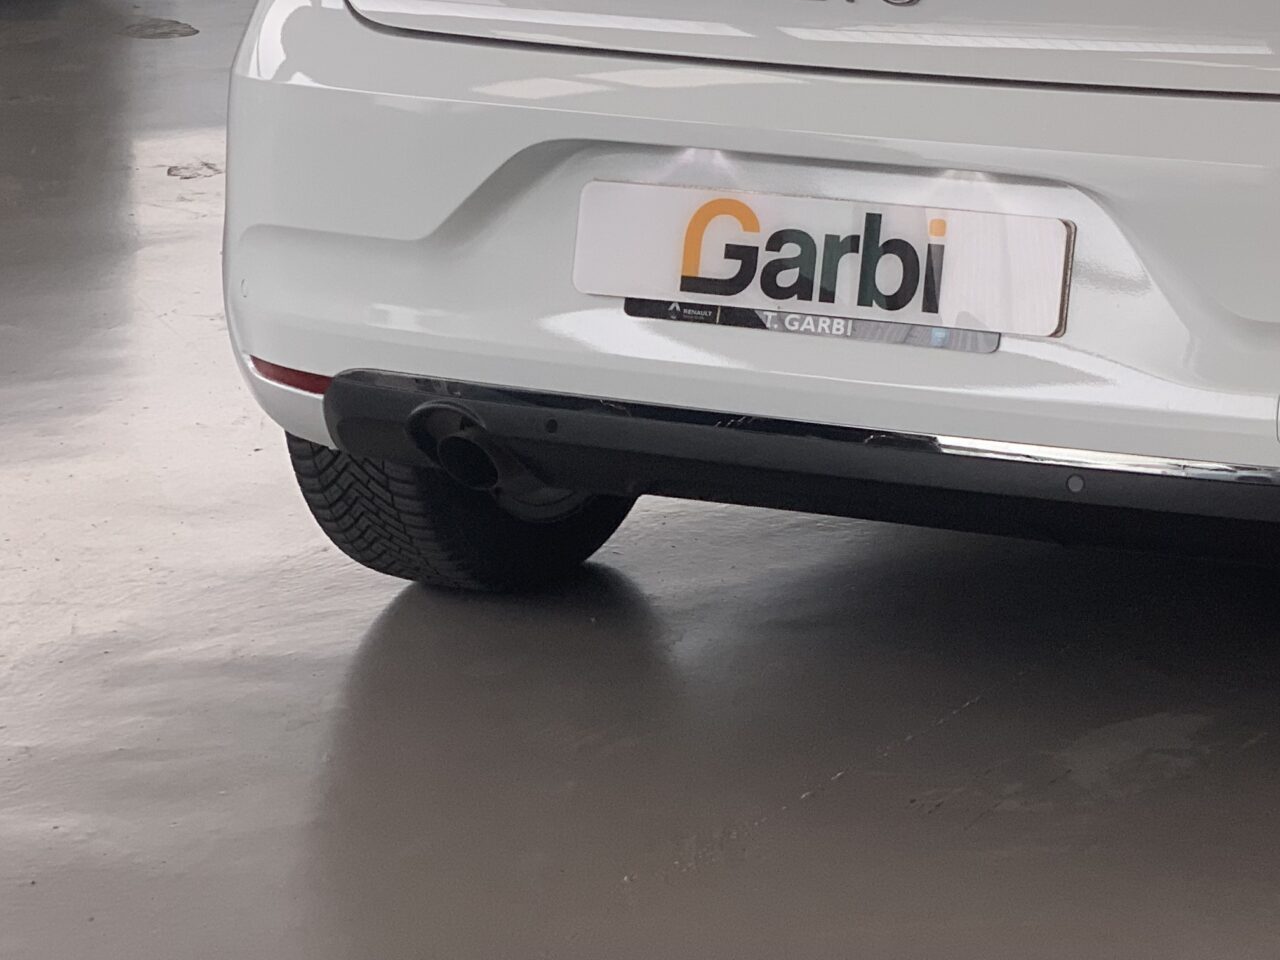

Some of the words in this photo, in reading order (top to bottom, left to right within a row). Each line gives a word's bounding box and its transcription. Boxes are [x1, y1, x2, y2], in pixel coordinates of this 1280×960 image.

[679, 198, 947, 314] Garbi
[683, 308, 712, 317] RENAULT
[784, 314, 853, 336] GARBI
